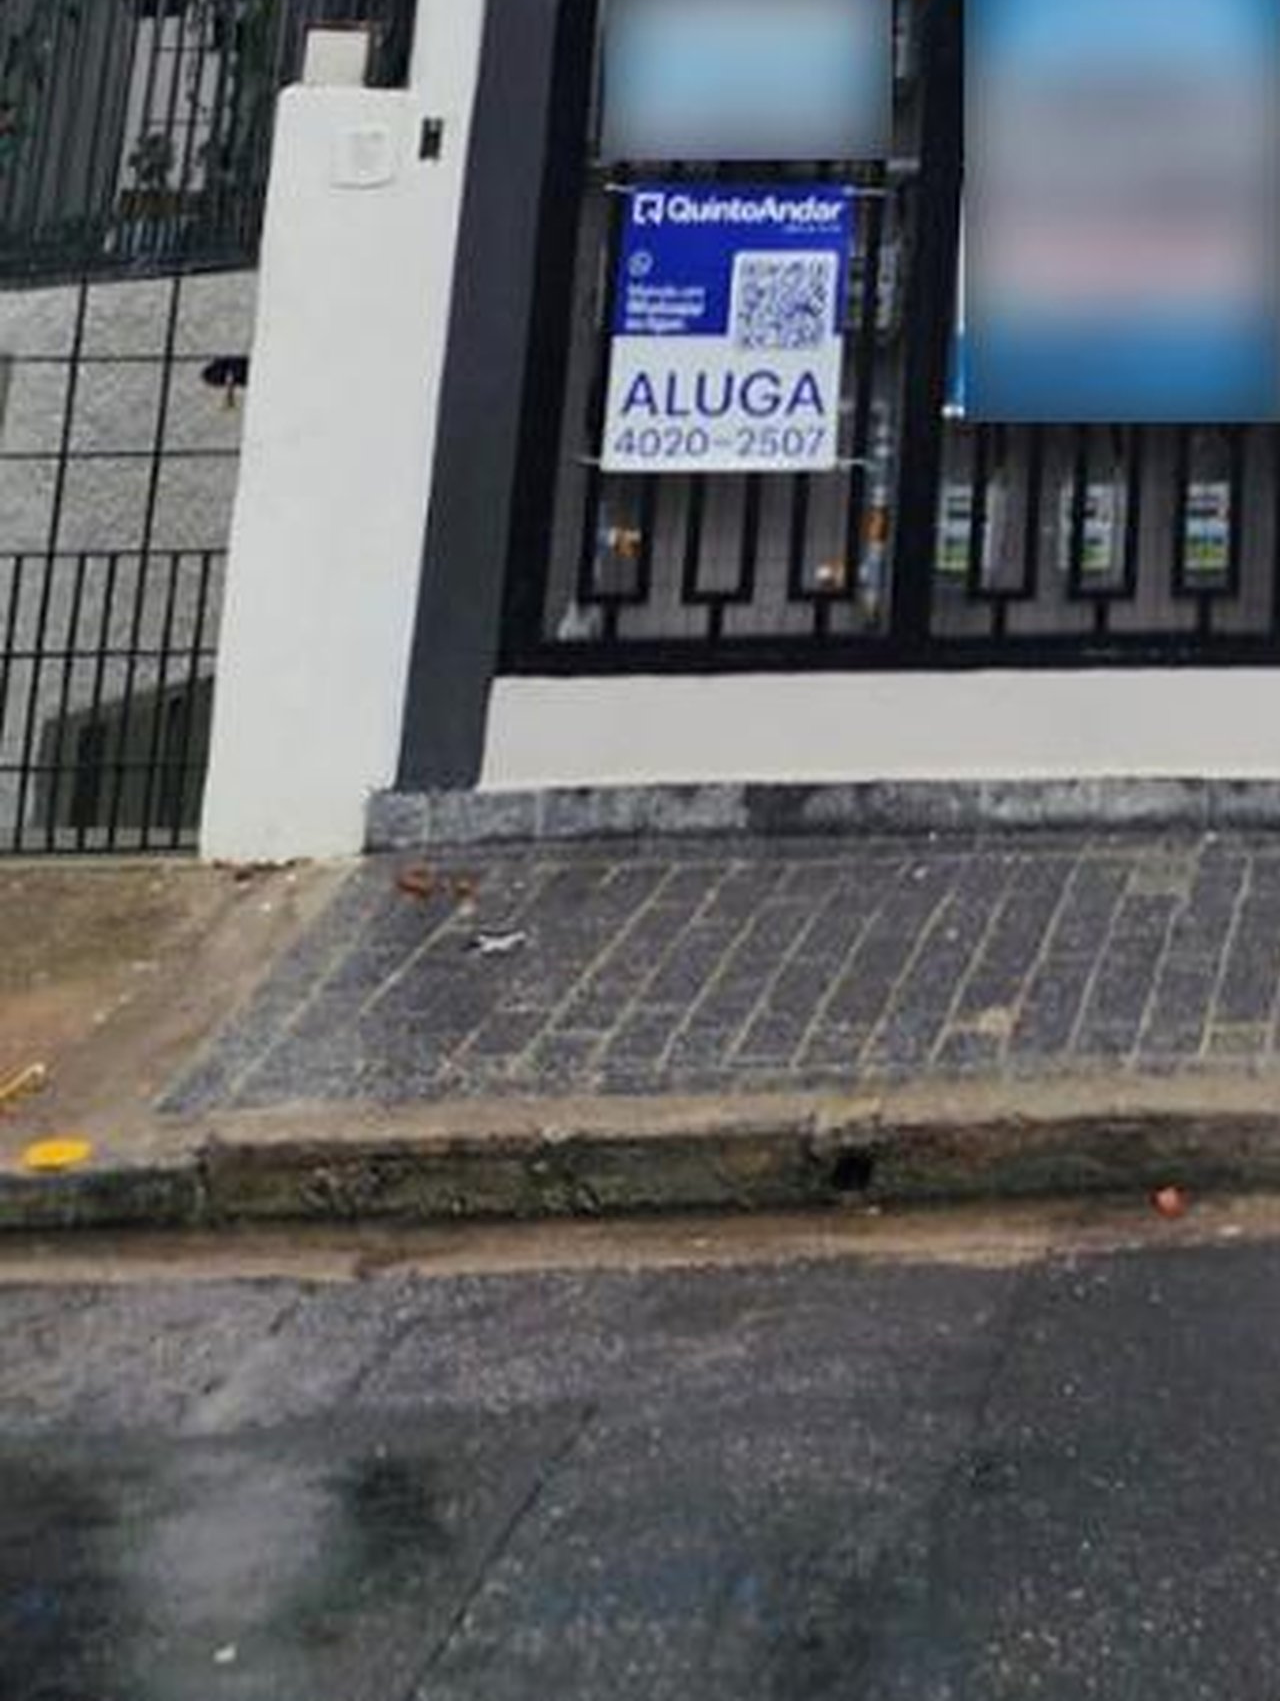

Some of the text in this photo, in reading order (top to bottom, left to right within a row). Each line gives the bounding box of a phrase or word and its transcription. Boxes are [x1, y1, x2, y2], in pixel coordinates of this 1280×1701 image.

[667, 194, 842, 224] QuintoAndar
[622, 371, 825, 418] ALUGA
[614, 427, 825, 459] 4020-2507
